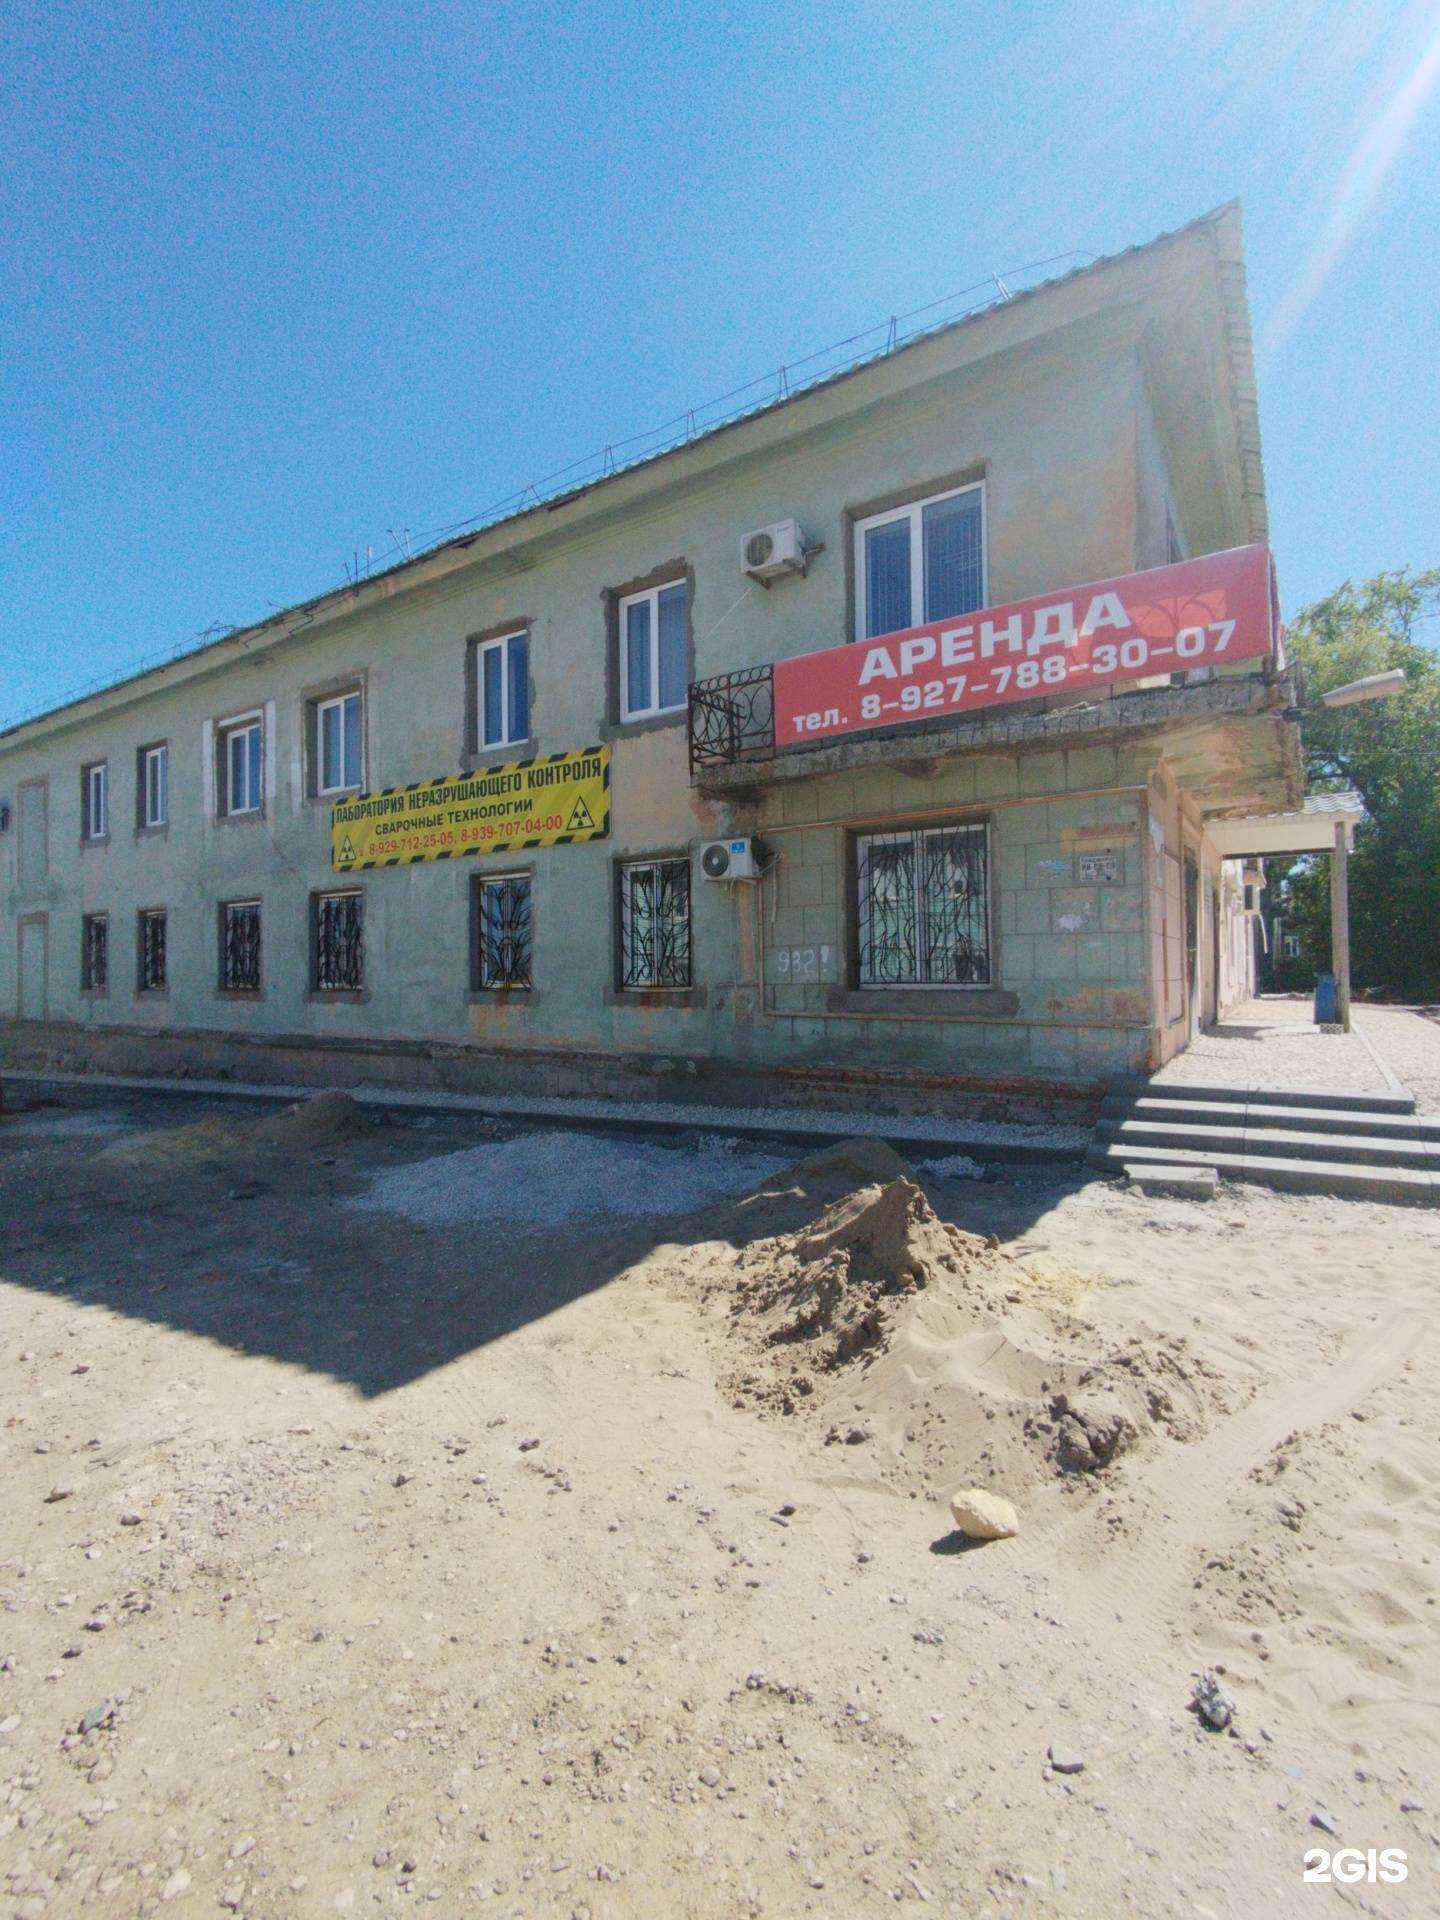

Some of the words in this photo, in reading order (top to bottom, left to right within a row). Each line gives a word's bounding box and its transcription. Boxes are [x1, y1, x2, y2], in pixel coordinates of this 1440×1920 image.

[857, 592, 1133, 685] АРЕНДА
[792, 709, 848, 733] тел.
[860, 620, 1237, 719] 8-927-788-30-07
[336, 795, 404, 823] ЛАБОРАТОРИЯ
[409, 772, 522, 810] НЕРАЗРУШАЮЩЕГО
[528, 758, 601, 788] КОНТРОЛЯ
[375, 814, 444, 836] СВАРОЧНЫЕ
[448, 799, 533, 824] ТЕХНОЛОГИИ
[461, 815, 563, 842] 8-939-707-04-00
